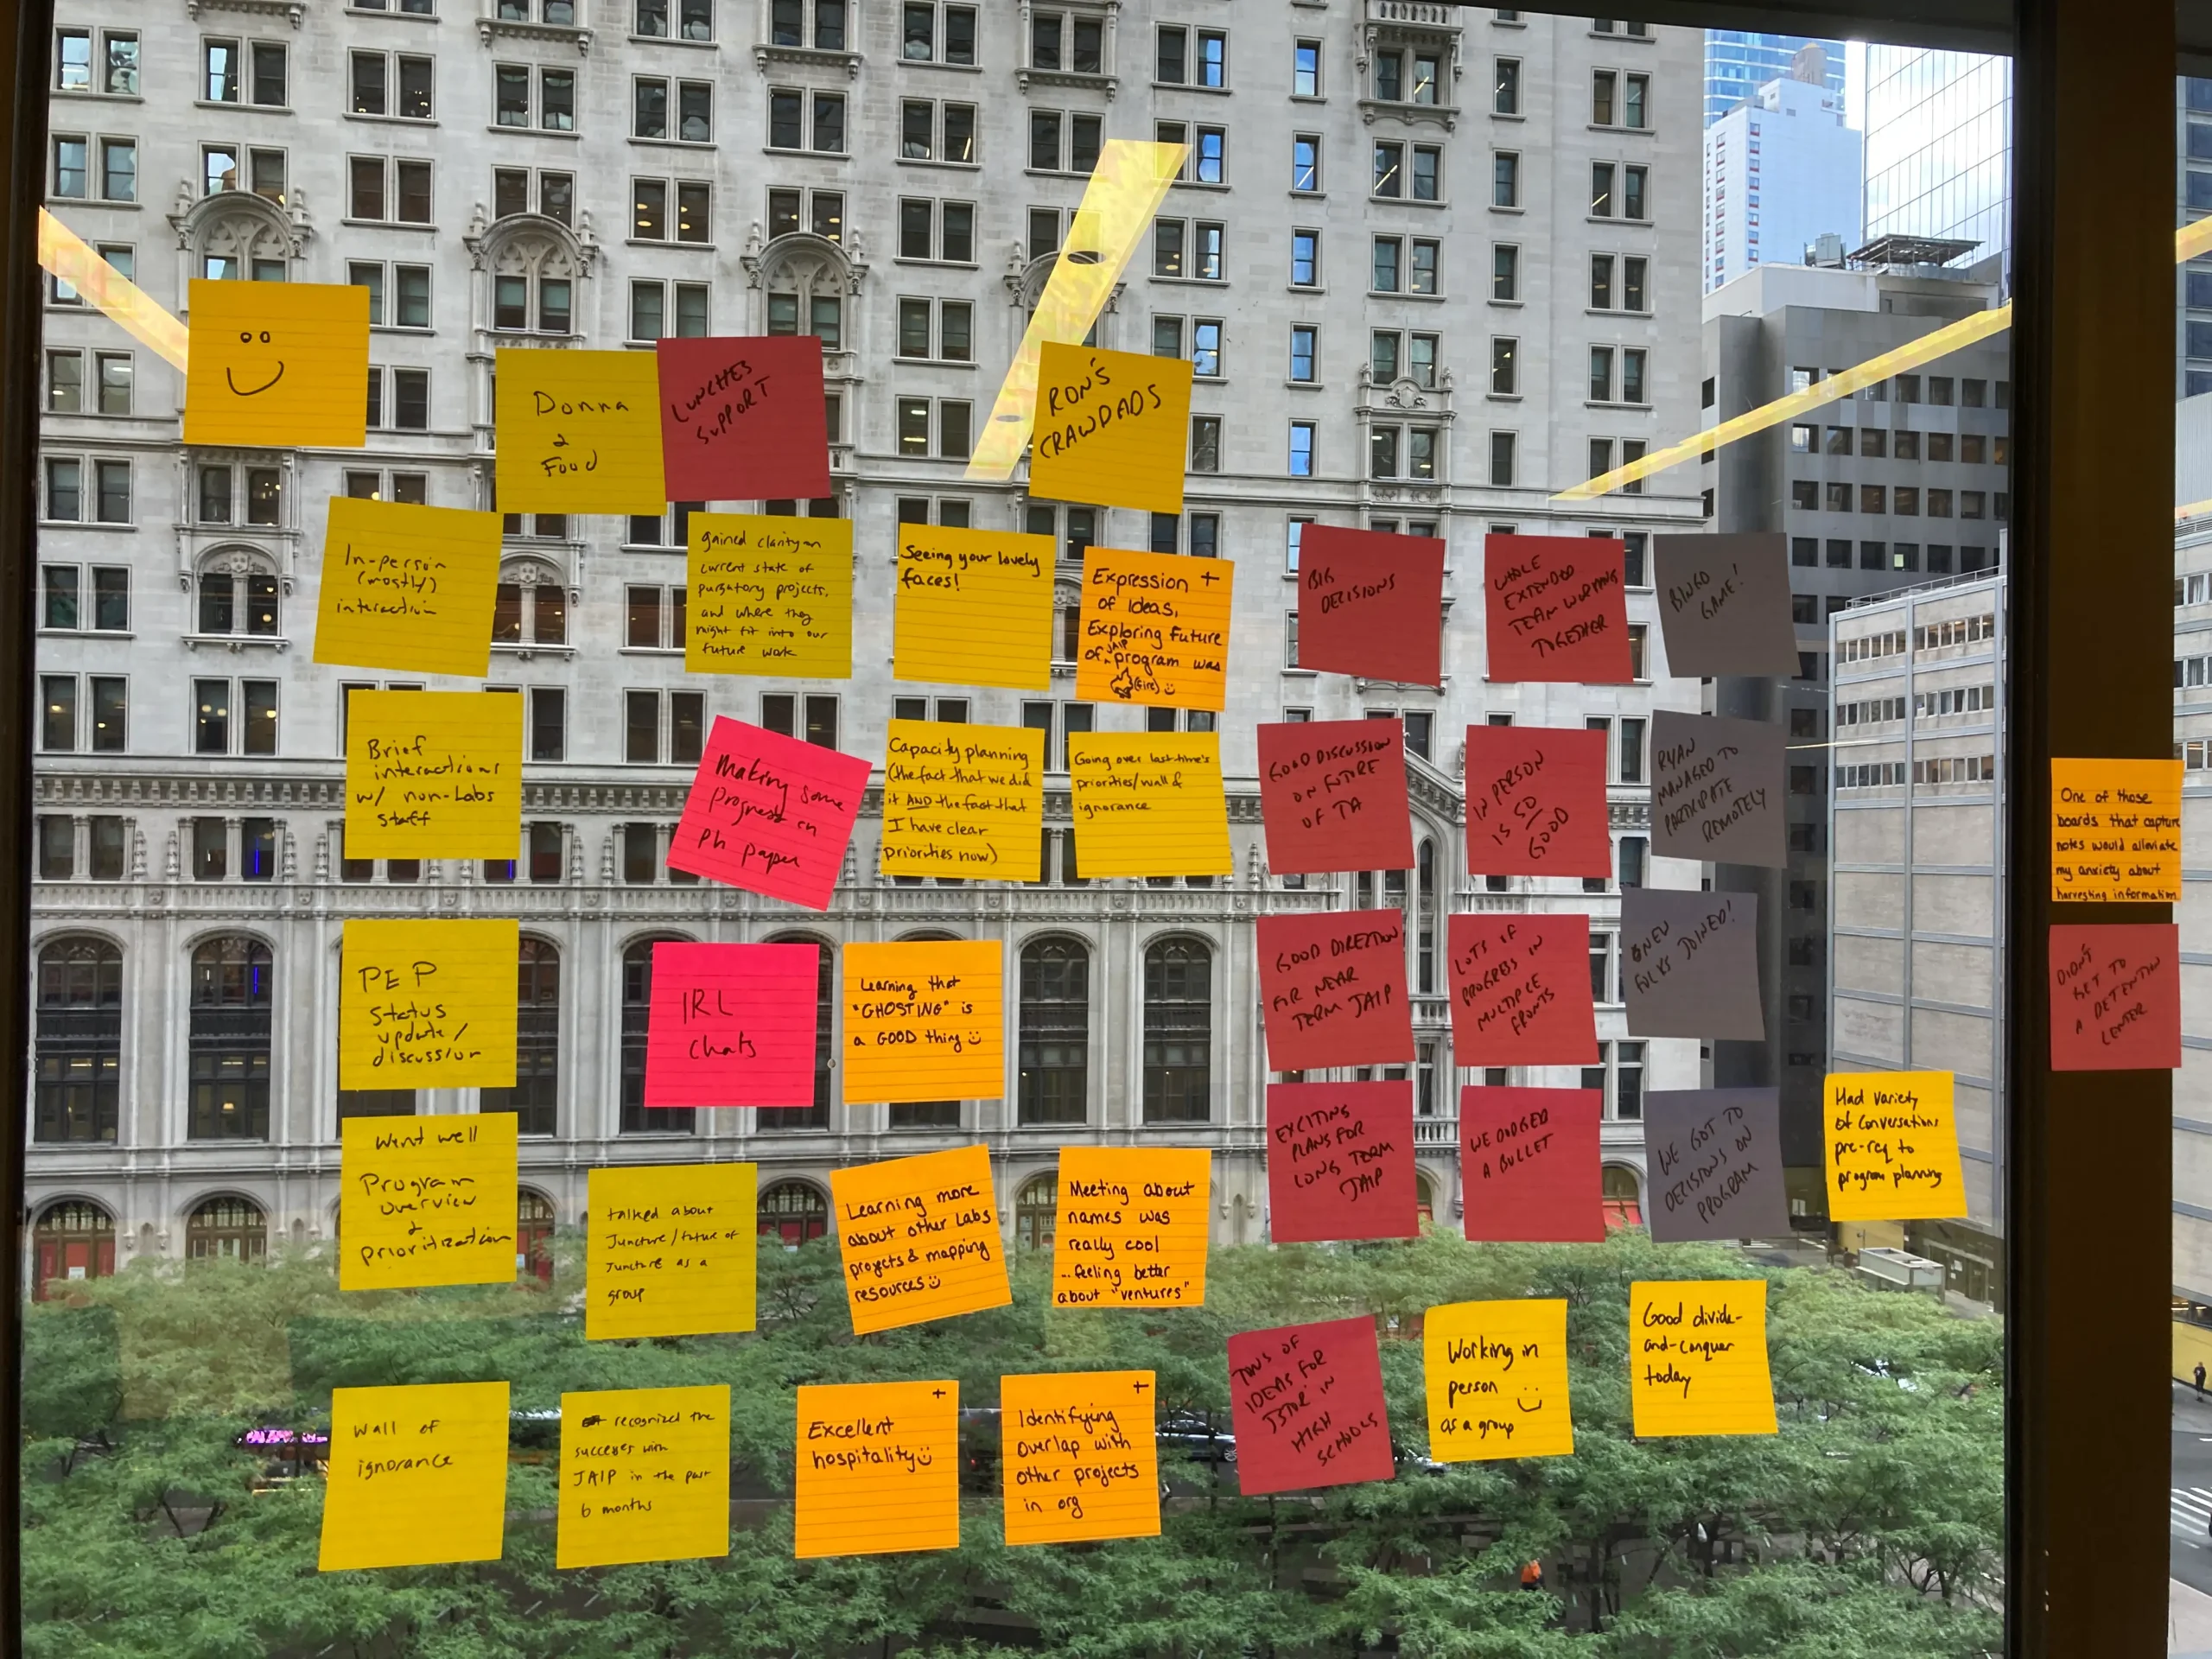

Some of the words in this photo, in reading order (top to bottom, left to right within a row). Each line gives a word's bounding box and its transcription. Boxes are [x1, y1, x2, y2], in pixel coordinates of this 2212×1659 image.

[532, 390, 629, 416] Donna
[1039, 379, 1161, 459] CRAWDADS
[899, 544, 953, 569] Seeing
[958, 553, 993, 570] your
[997, 550, 1041, 578] lovely
[1091, 567, 1189, 596] Expression
[1669, 570, 1711, 613] BINGO
[735, 606, 773, 619] where
[1097, 595, 1116, 611] of
[1507, 606, 1559, 636] TEAM
[1087, 619, 1163, 653] Exploring
[1084, 645, 1104, 662] of
[1113, 652, 1179, 677] program
[1193, 659, 1221, 672] was
[367, 734, 427, 760] Brief
[888, 736, 961, 765] Capacity
[964, 743, 1029, 771] planning
[1657, 736, 1695, 772] RYAN
[1074, 751, 1112, 772] Going
[1116, 755, 1141, 765] over
[988, 775, 1006, 785] we
[1008, 772, 1033, 787] did
[1491, 749, 1544, 810] PERSON
[1657, 756, 1715, 810] MANAGED
[2060, 786, 2087, 804] One
[2094, 790, 2109, 804] of
[2117, 789, 2153, 804] those
[1078, 802, 1152, 820] ignorance
[2056, 812, 2099, 828] boards
[2108, 813, 2139, 829] that
[909, 816, 942, 833] have
[946, 821, 988, 836] clear
[1529, 807, 1569, 859] GOOD
[2056, 837, 2085, 852] notes
[2091, 837, 2125, 852] would
[2056, 866, 2074, 882] my
[2077, 864, 2120, 882] anxiety
[2128, 862, 2161, 877] about
[860, 977, 918, 1001] Learning
[927, 975, 961, 992] that
[961, 1001, 973, 1014] is
[853, 1036, 866, 1046] a
[876, 1029, 918, 1046] GOOD
[925, 1028, 963, 1053] thing
[437, 1125, 478, 1144] well
[1897, 1138, 1915, 1154] to
[846, 1196, 927, 1221] Learning
[936, 1185, 980, 1204] more
[1070, 1179, 1129, 1206] Meeting
[1143, 1180, 1195, 1198] about
[671, 1205, 714, 1217] about
[1067, 1211, 1122, 1225] names
[1139, 1210, 1171, 1225] was
[848, 1225, 896, 1248] about
[907, 1217, 947, 1237] other
[925, 1237, 990, 1263] mapping
[1068, 1236, 1115, 1261] really
[1125, 1235, 1160, 1253] cool
[1134, 1263, 1171, 1281] better
[855, 1275, 925, 1303] resources
[1057, 1288, 1101, 1304] about
[1643, 1301, 1683, 1328] Good
[1447, 1335, 1514, 1372] Working
[1522, 1343, 1539, 1358] in
[1643, 1362, 1692, 1399] today
[1448, 1380, 1498, 1409] person
[807, 1415, 895, 1440] Excellent
[1019, 1405, 1122, 1438] Identifying
[1478, 1419, 1515, 1440] group
[1095, 1434, 1131, 1451] with
[812, 1444, 916, 1473] hospitality
[1073, 1461, 1140, 1488] projects
[1024, 1500, 1043, 1514] in
[1058, 1496, 1084, 1520] org
